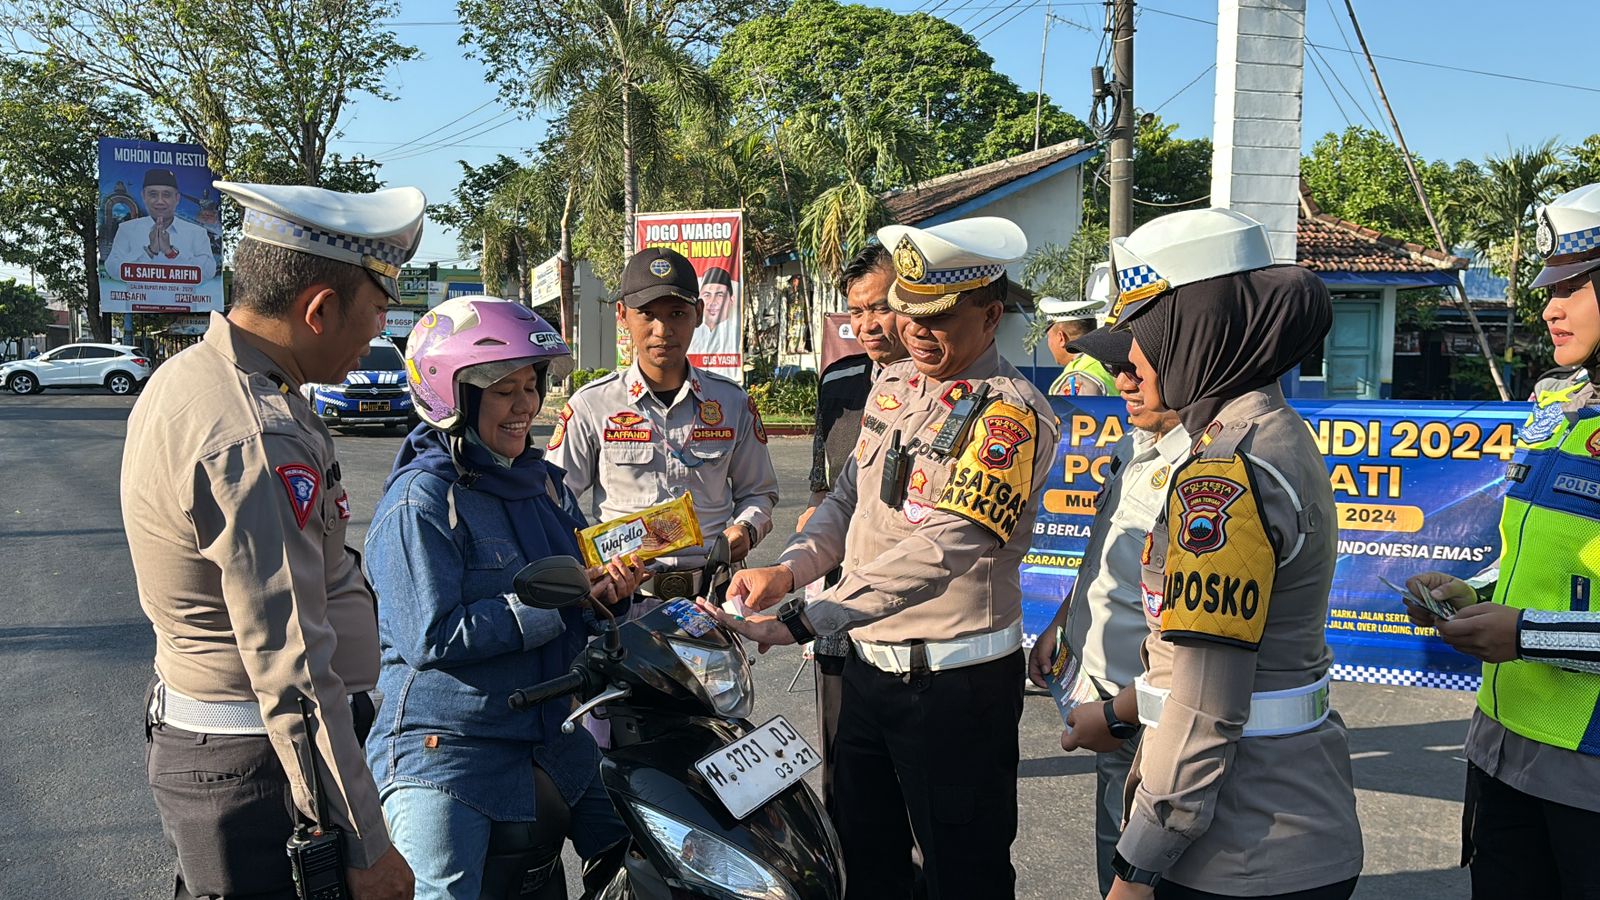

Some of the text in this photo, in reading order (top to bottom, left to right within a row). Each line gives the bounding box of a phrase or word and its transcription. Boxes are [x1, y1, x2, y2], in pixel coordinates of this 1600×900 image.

[114, 147, 206, 167] MOHON DOA RESTU
[645, 222, 732, 241] JOGO WARGO
[691, 240, 732, 258] MULYO
[124, 266, 198, 281] H. SAIFUL ARIFIN
[110, 291, 147, 301] #MASAFIN
[174, 293, 212, 304] #PATIMUKTI
[702, 354, 739, 366] GUS YASIN
[694, 430, 732, 438] DISHUB
[1069, 414, 1133, 448] PA
[1389, 420, 1515, 461] 2024
[1183, 481, 1232, 494] POLRESTA
[1556, 476, 1600, 496] POLIS
[1344, 507, 1398, 525] 2024
[601, 525, 644, 554] Wafello
[1337, 540, 1430, 561] INDONESIA
[1330, 608, 1410, 623] MARKA JALAN SERTA
[1356, 622, 1378, 633] OVER
[1413, 627, 1436, 637] OVER
[705, 720, 797, 788] H 3731 DJ
